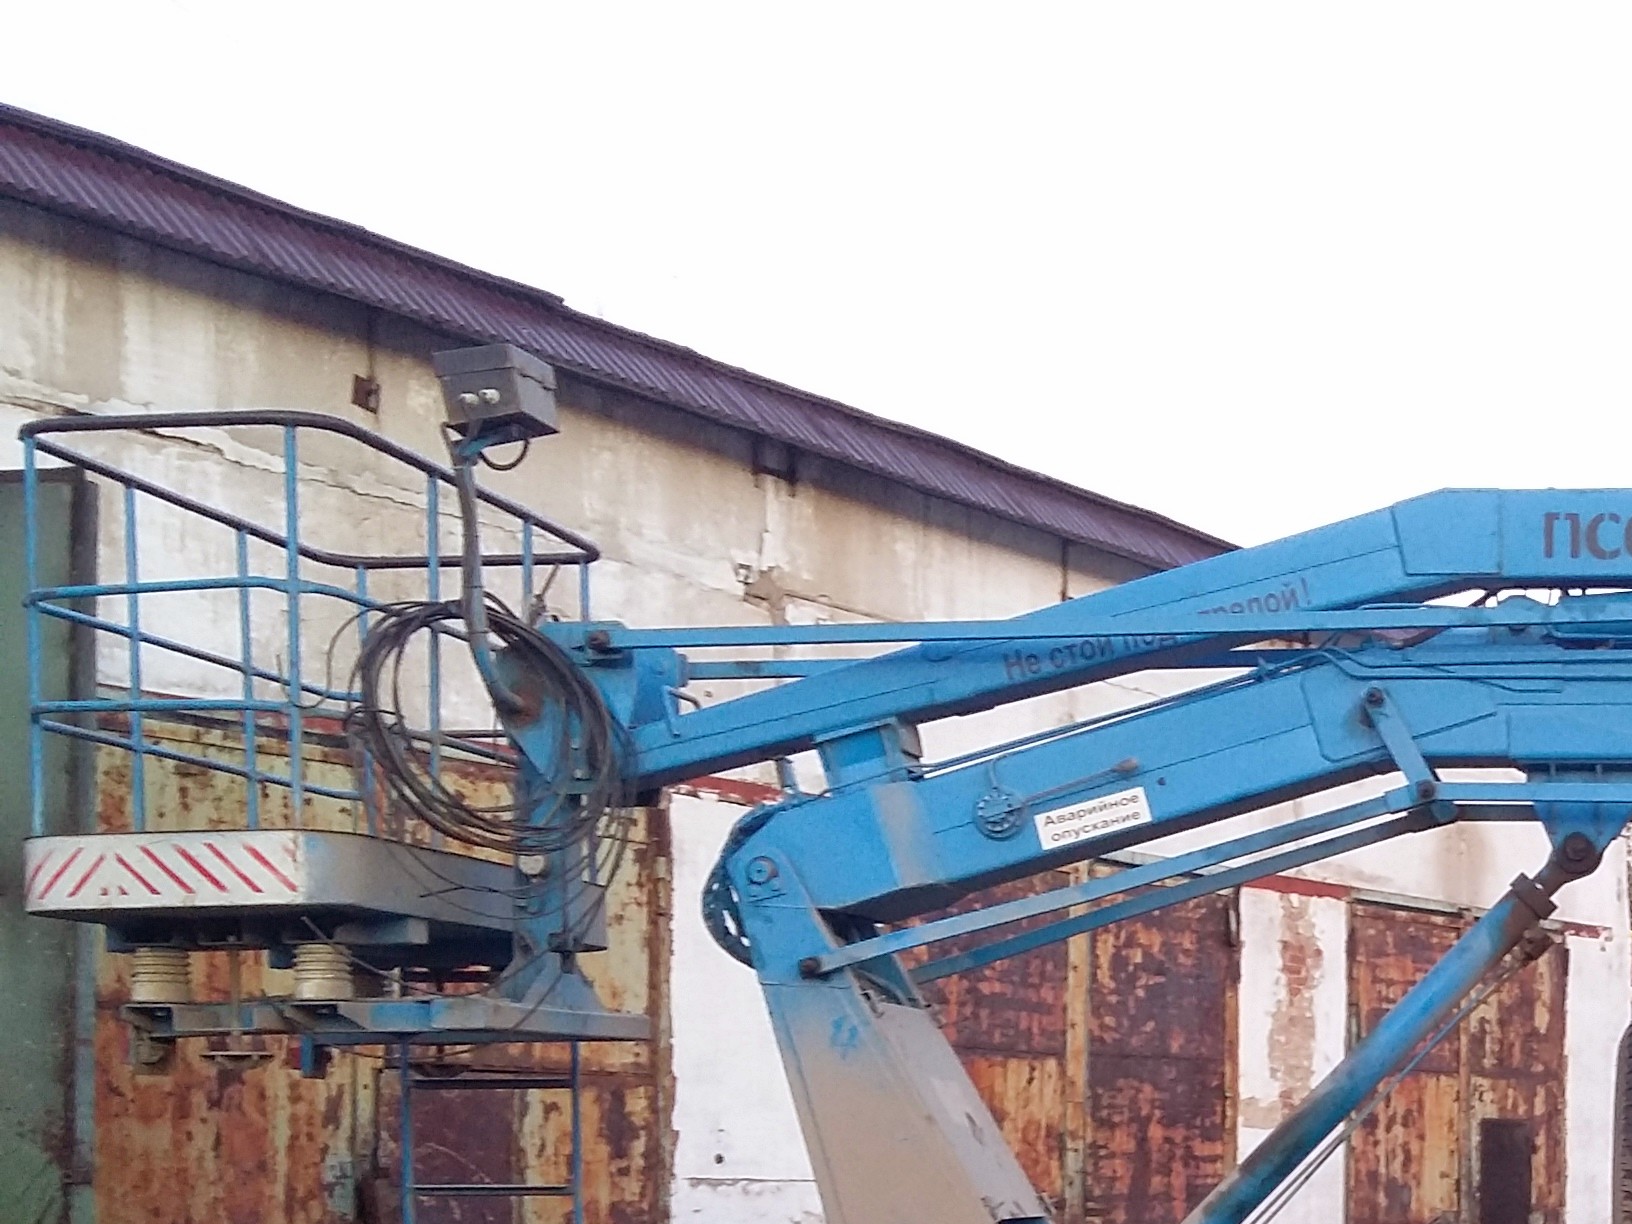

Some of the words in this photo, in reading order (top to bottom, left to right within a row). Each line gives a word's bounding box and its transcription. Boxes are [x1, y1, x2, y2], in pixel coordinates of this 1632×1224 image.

[1003, 648, 1042, 682] Не
[1043, 794, 1139, 827] Аварийное
[1050, 811, 1141, 841] опускание
